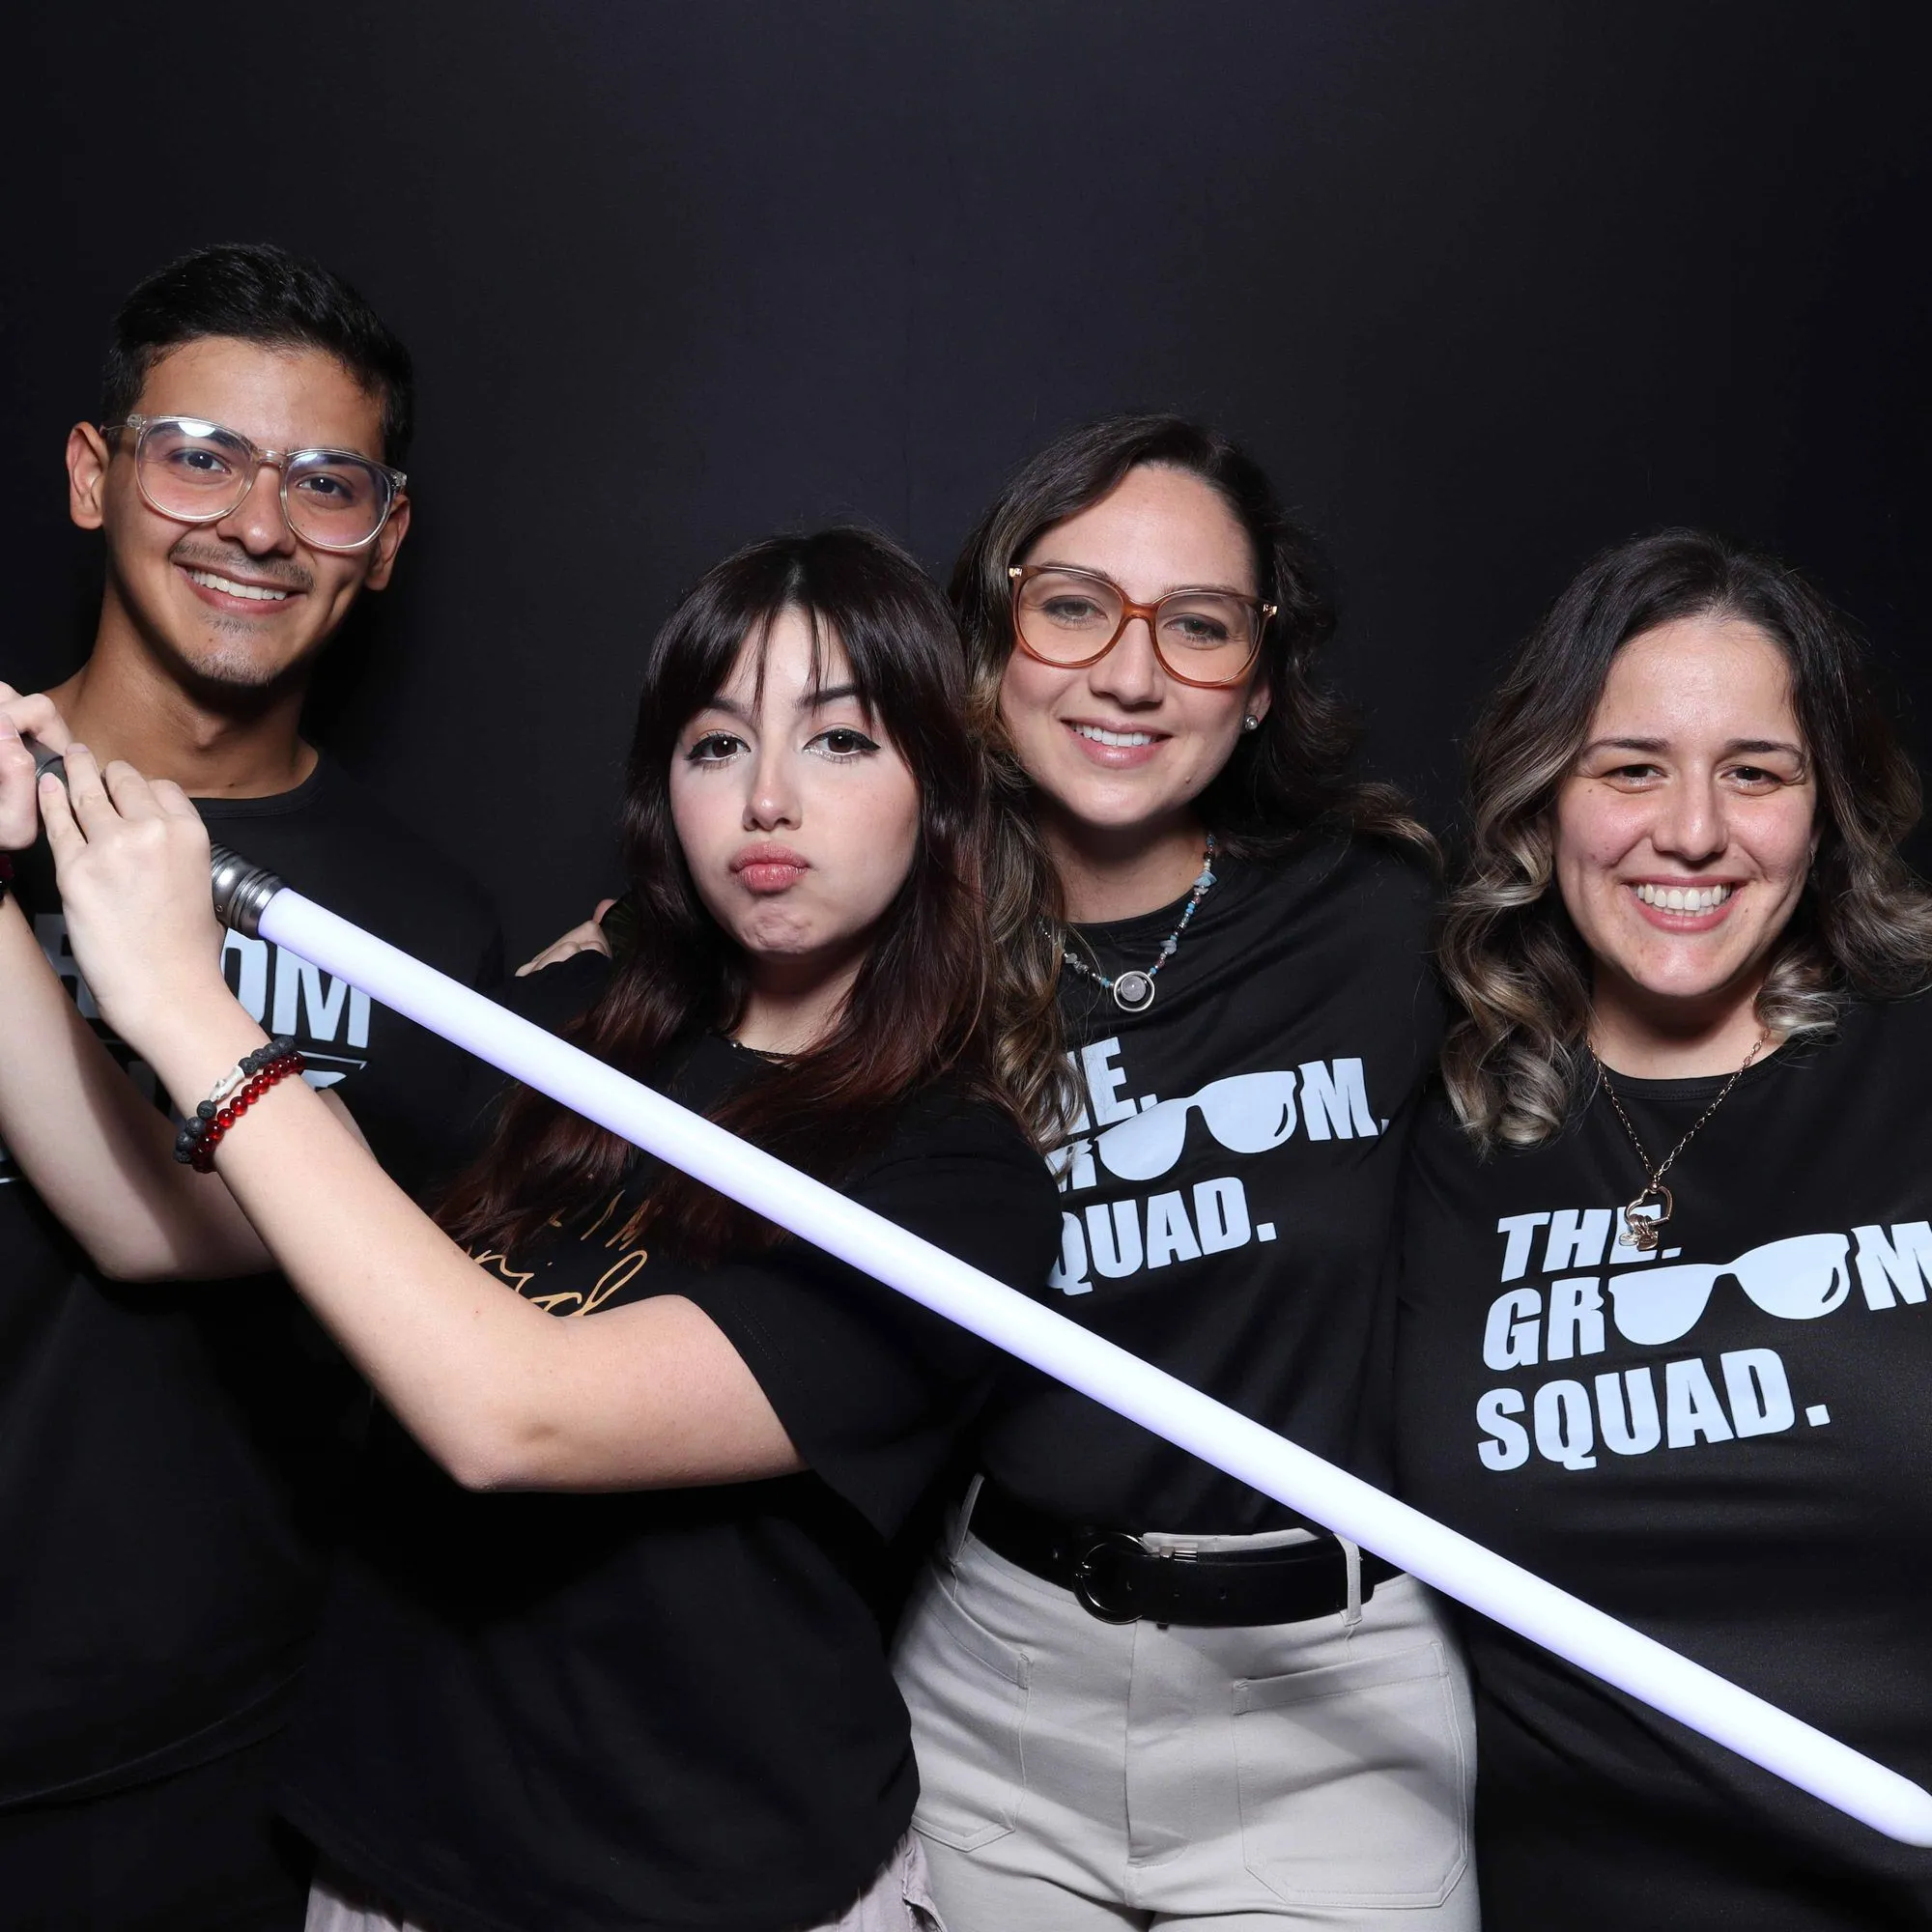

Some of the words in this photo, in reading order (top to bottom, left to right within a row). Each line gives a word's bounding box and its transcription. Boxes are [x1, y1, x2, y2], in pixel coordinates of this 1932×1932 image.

[1046, 1176, 1278, 1296] QUAD.
[1497, 1204, 1683, 1283] THE.
[1475, 1348, 1832, 1472] SQUAD.
